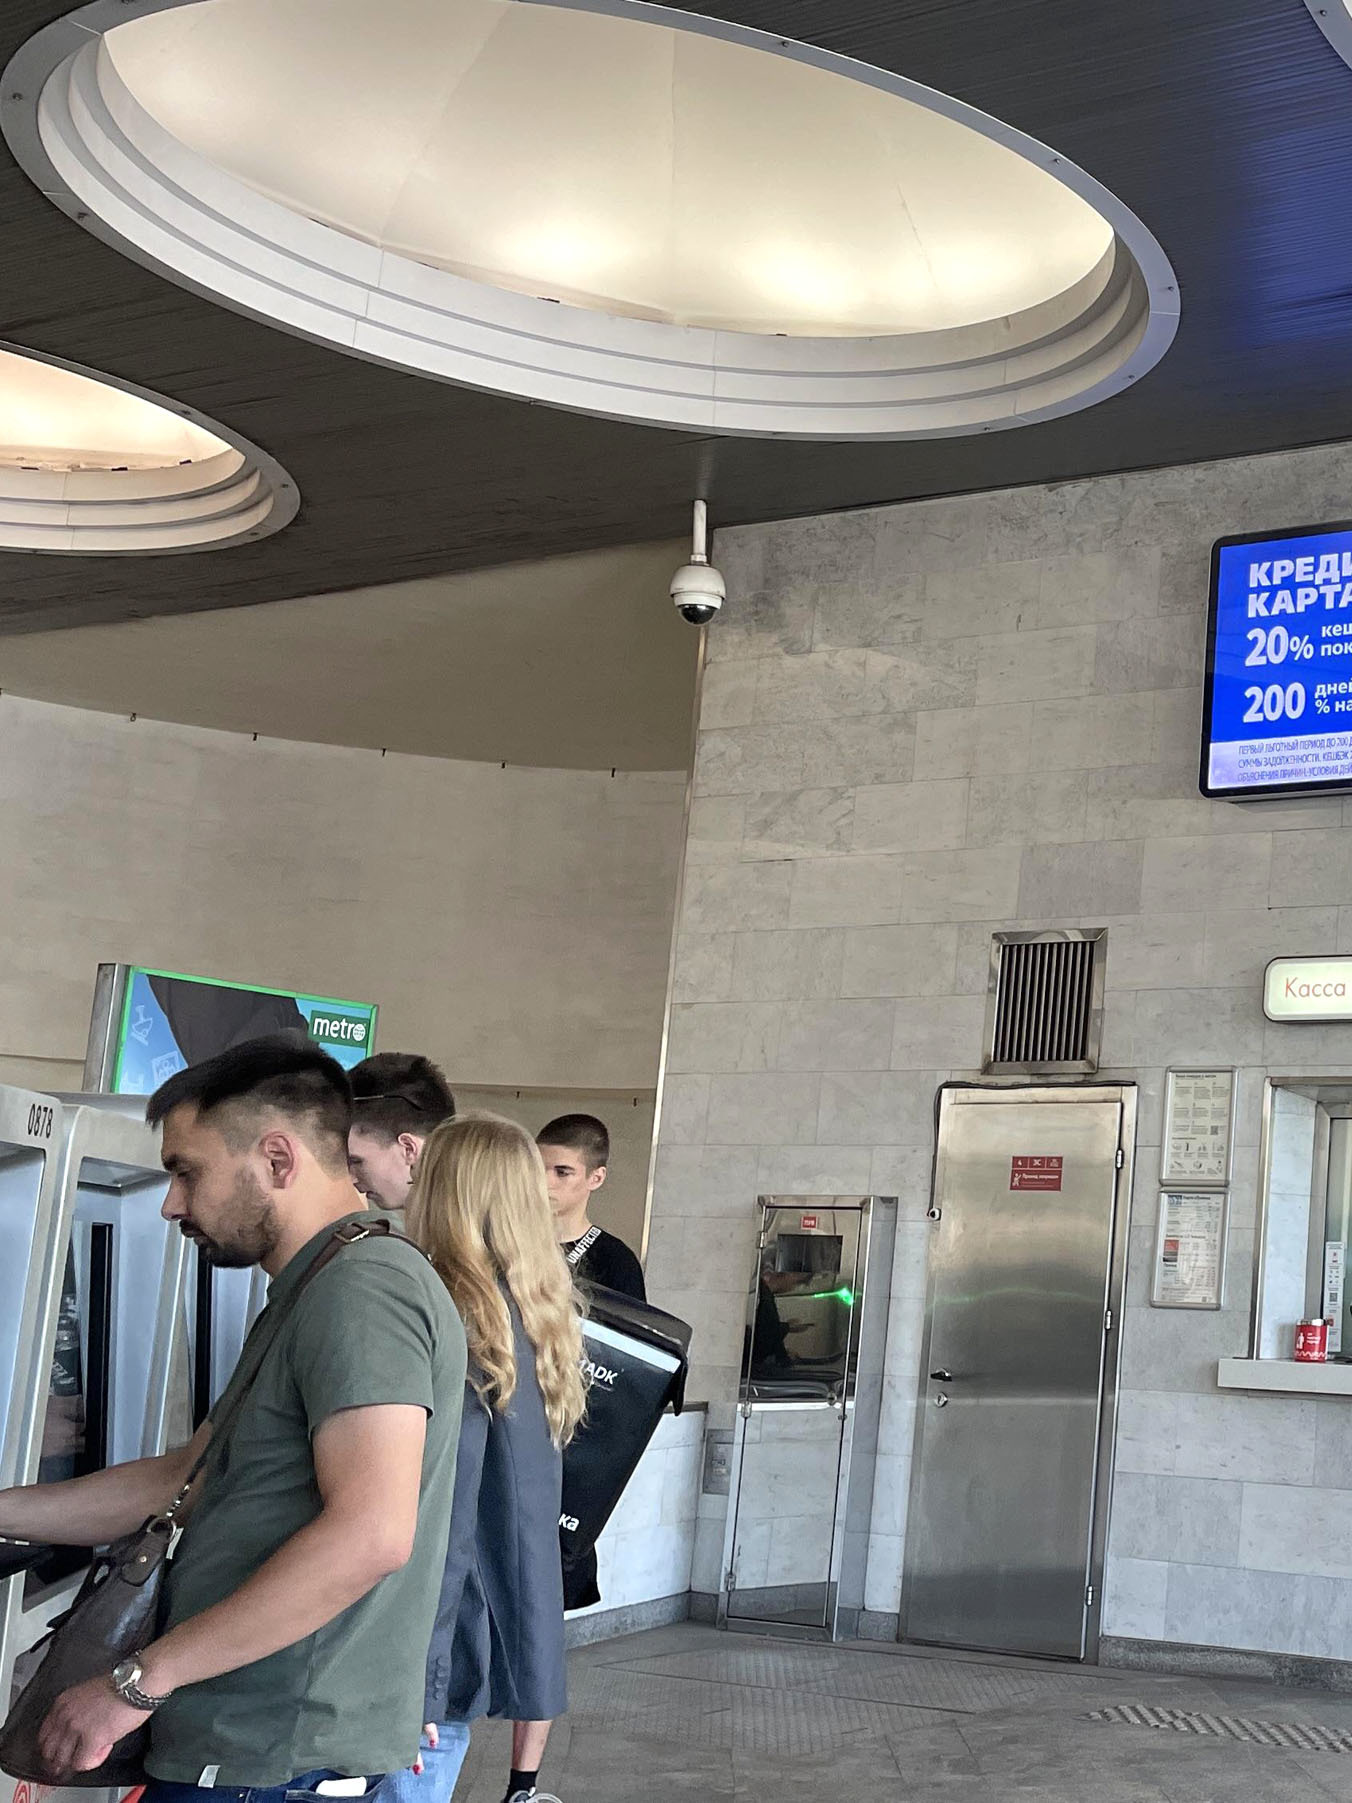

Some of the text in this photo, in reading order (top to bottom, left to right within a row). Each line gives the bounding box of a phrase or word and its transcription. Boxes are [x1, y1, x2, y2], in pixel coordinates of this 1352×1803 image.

[1245, 625, 1314, 667] 20%
[1242, 682, 1306, 723] 200
[1315, 699, 1330, 714] %
[1284, 976, 1346, 998] Касса
[313, 1017, 366, 1042] metro
[28, 1103, 53, 1139] 0878
